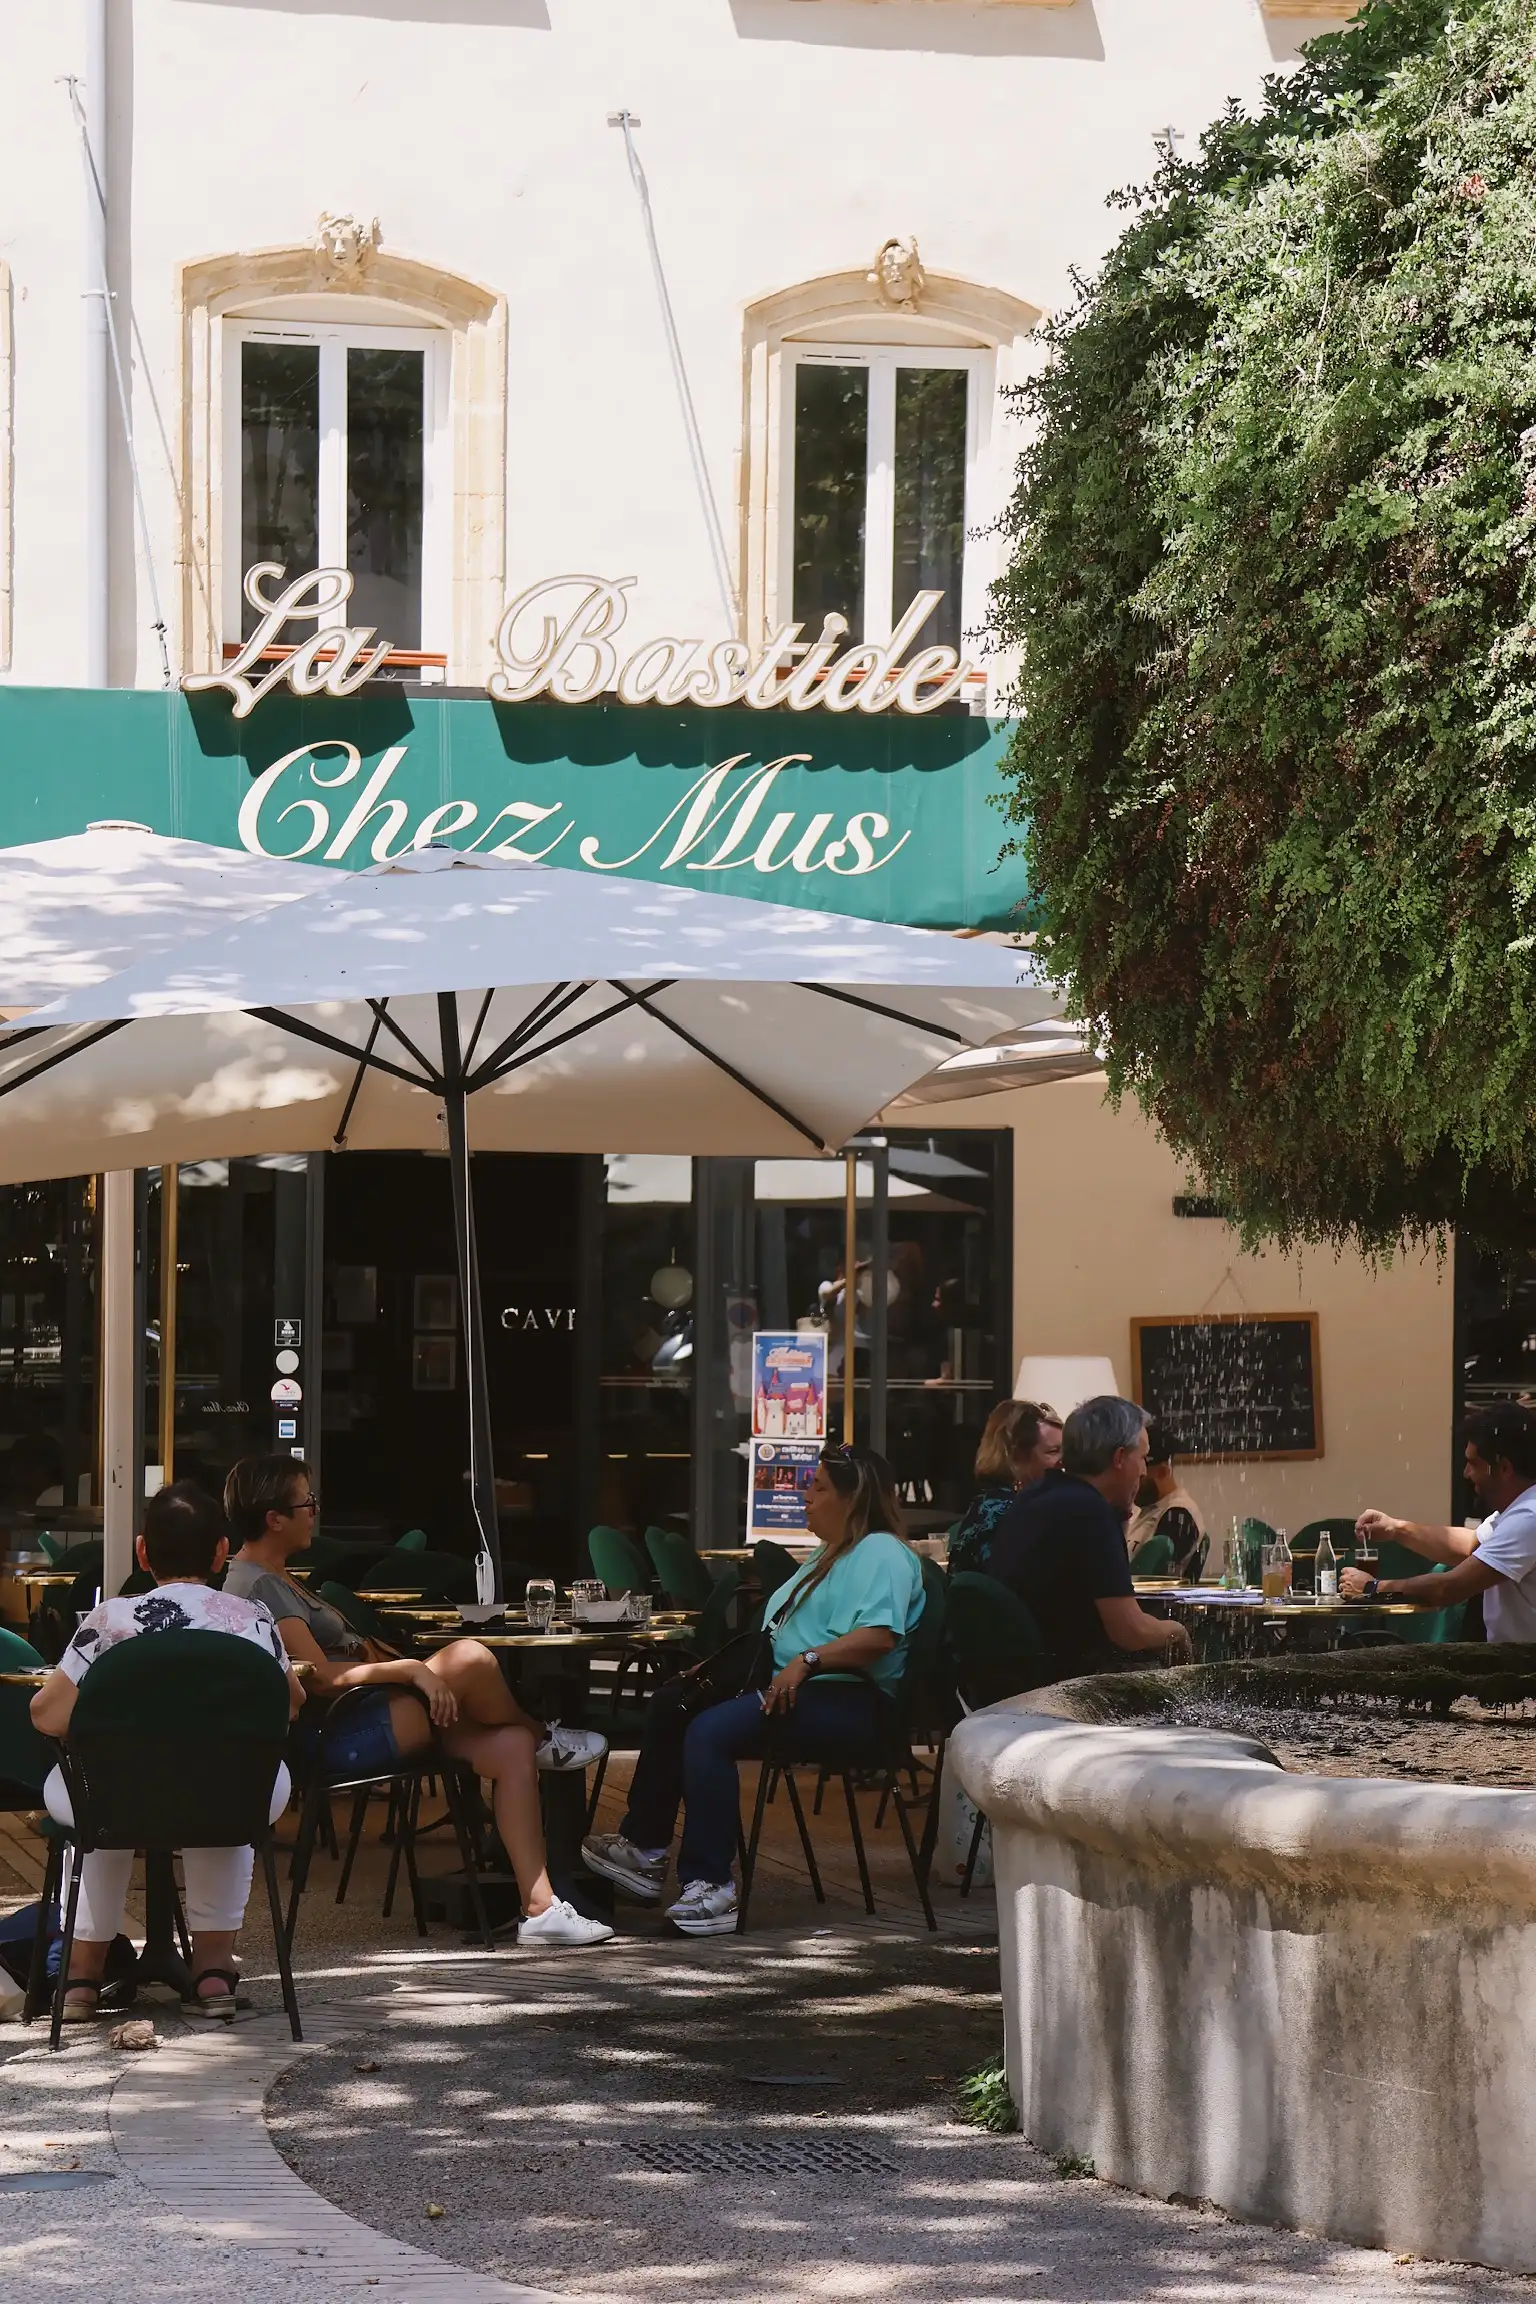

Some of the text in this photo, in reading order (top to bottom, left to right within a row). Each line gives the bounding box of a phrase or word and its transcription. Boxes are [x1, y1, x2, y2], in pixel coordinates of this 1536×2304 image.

[181, 560, 974, 719] La Bastide
[237, 740, 912, 876] Chez Mus
